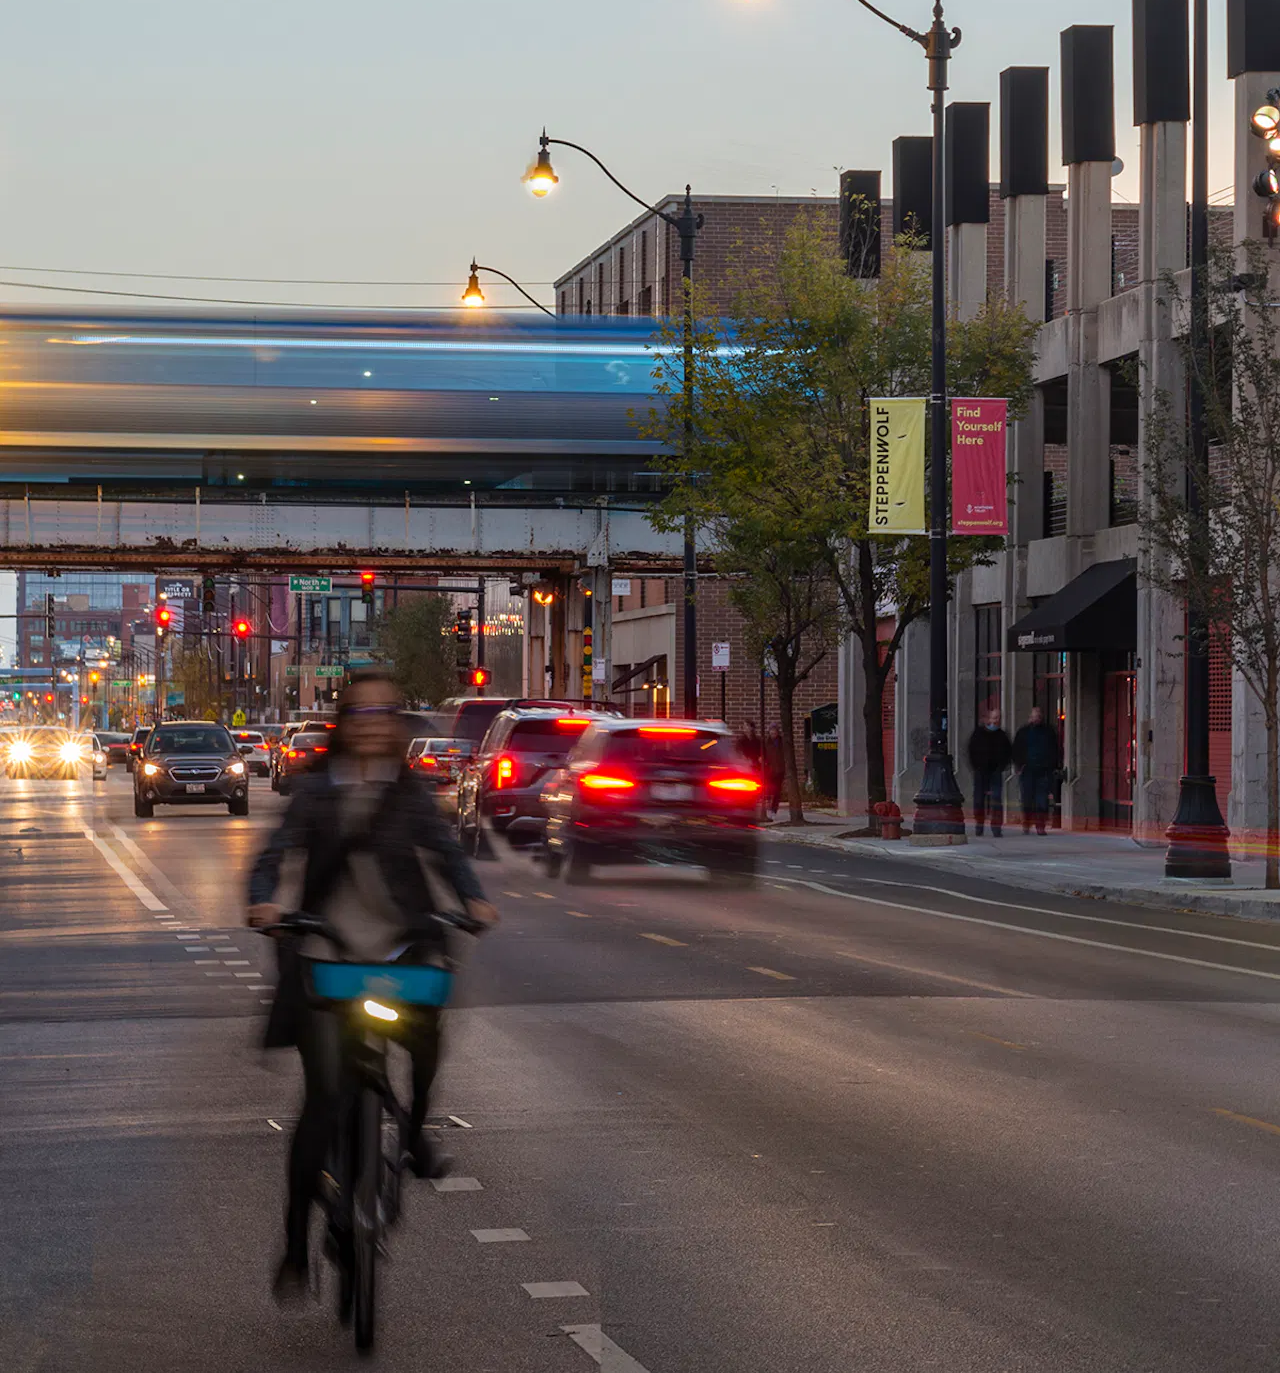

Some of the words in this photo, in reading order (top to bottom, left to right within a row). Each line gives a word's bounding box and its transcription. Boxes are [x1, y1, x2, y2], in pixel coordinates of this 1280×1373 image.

[956, 406, 981, 418] Find
[956, 420, 1003, 432] Yourself
[956, 434, 984, 445] Here
[876, 406, 890, 526] STEPPENWOLF
[957, 519, 1004, 527] steppenwolf.org
[299, 578, 320, 586] North
